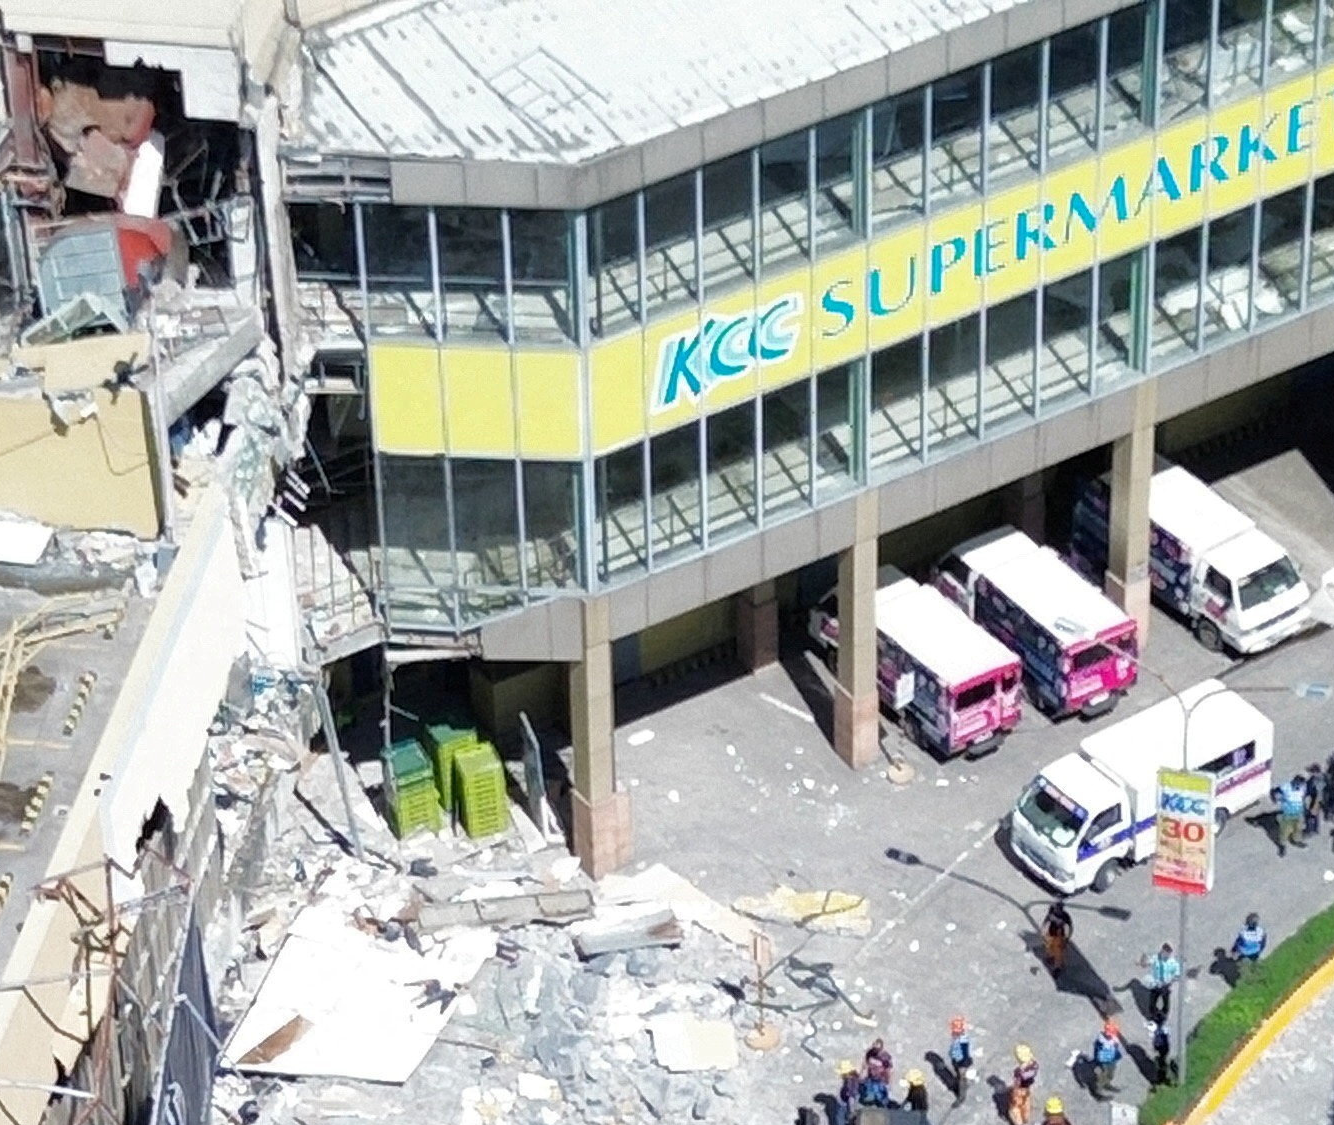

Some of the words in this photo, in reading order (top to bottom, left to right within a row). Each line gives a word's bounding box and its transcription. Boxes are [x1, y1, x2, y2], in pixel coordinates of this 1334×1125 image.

[653, 295, 801, 411] KCC
[1161, 792, 1208, 815] KCC
[1161, 816, 1205, 842] 30
